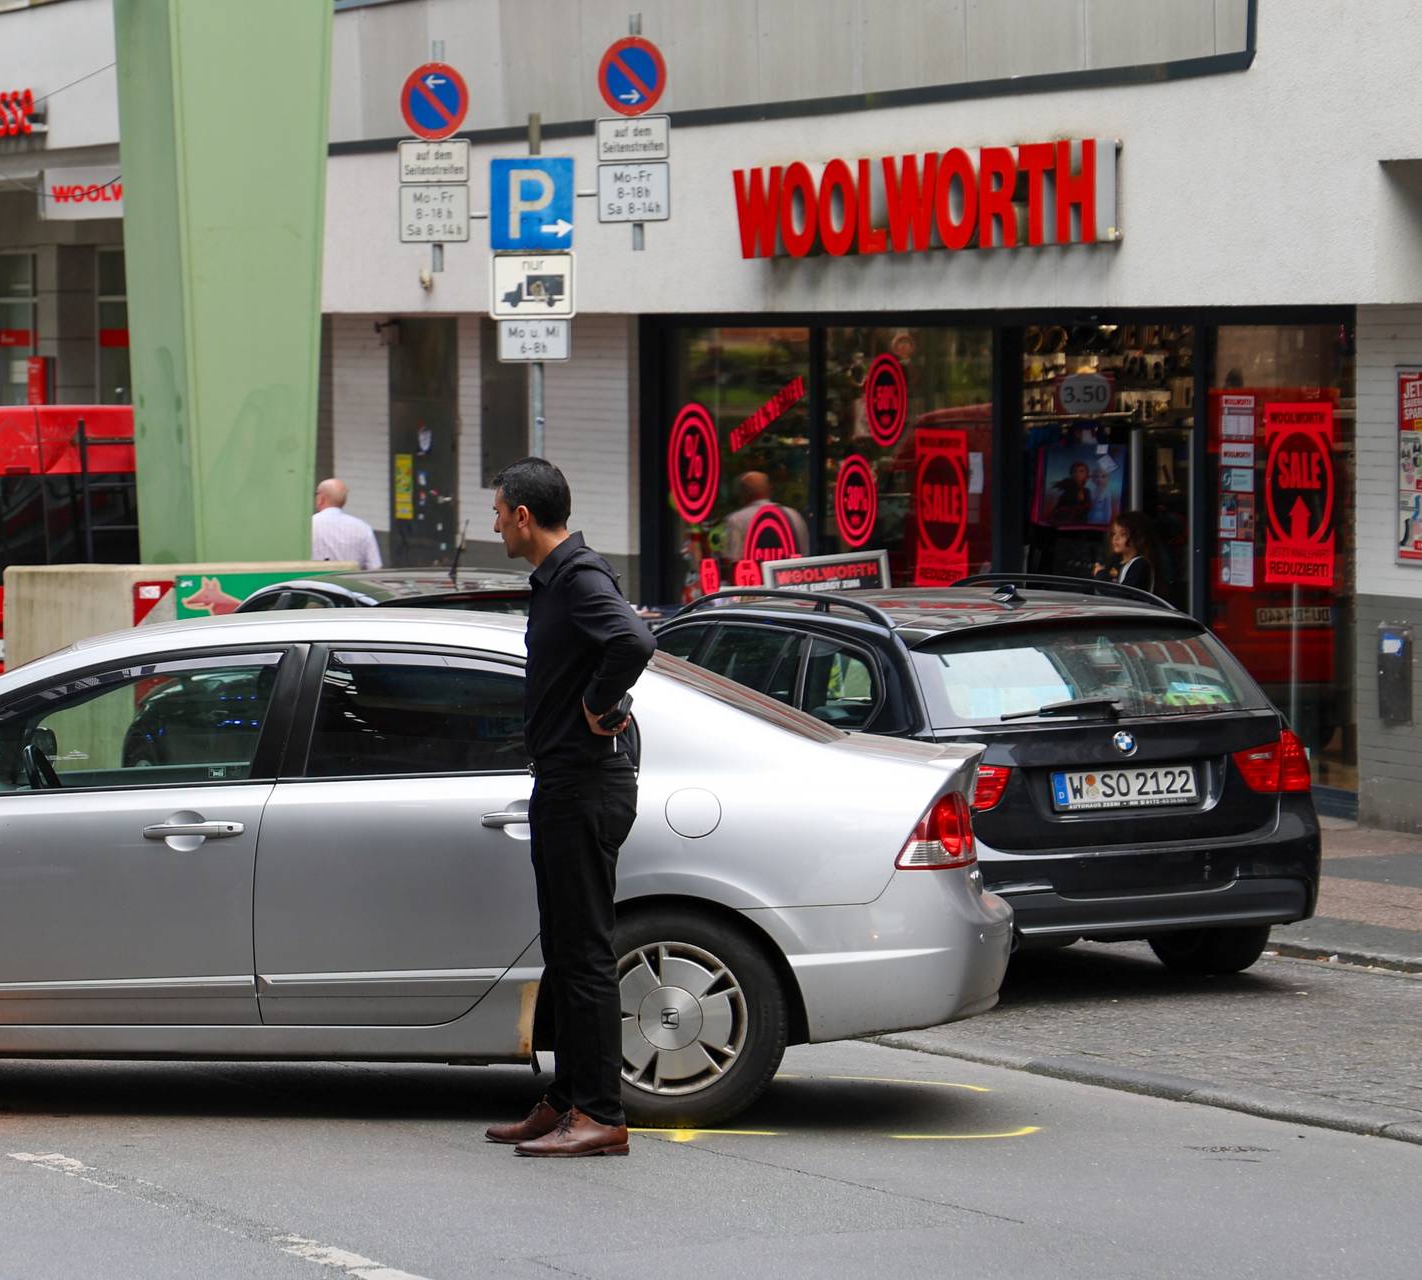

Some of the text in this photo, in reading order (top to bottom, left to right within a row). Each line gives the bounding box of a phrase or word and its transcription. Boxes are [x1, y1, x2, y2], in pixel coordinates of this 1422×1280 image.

[614, 126, 652, 137] auf dem
[602, 141, 664, 153] Seitenstreifen
[415, 150, 452, 160] auf dem
[404, 164, 464, 175] Seitenstreifen
[613, 169, 653, 183] Mo-Fr
[509, 169, 555, 240] P
[733, 139, 1096, 259] WOOLWORTH
[607, 203, 623, 215] Sa
[406, 224, 422, 236] Sa
[521, 259, 545, 271] nur
[507, 327, 525, 338] Mo
[545, 327, 560, 338] Mi
[1063, 385, 1107, 403] 3.50
[1270, 411, 1325, 425] WOOLWORTH
[1278, 452, 1322, 490] SALE
[922, 483, 961, 523] SALE
[775, 561, 878, 585] WOOLWORTH
[1269, 561, 1329, 578] REDUZIERT!
[1068, 769, 1193, 800] W SO 2122
